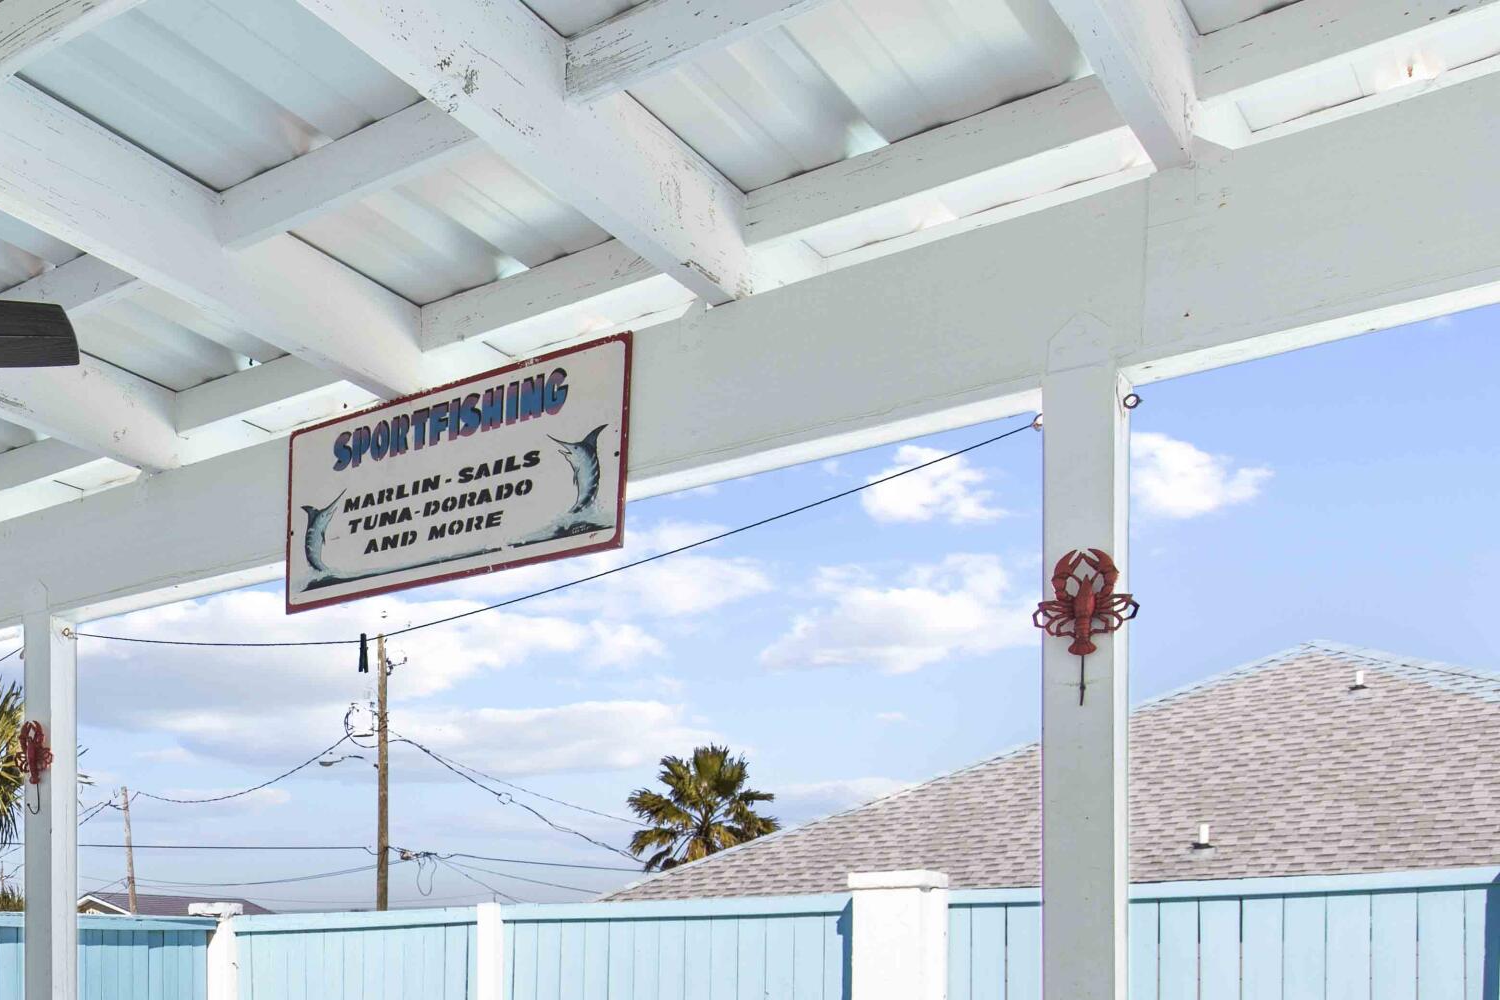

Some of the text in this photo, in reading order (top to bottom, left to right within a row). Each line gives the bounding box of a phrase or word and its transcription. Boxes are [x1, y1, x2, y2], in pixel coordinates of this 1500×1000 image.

[333, 367, 569, 471] SPORTFISHING
[364, 510, 504, 554] AND MORE
